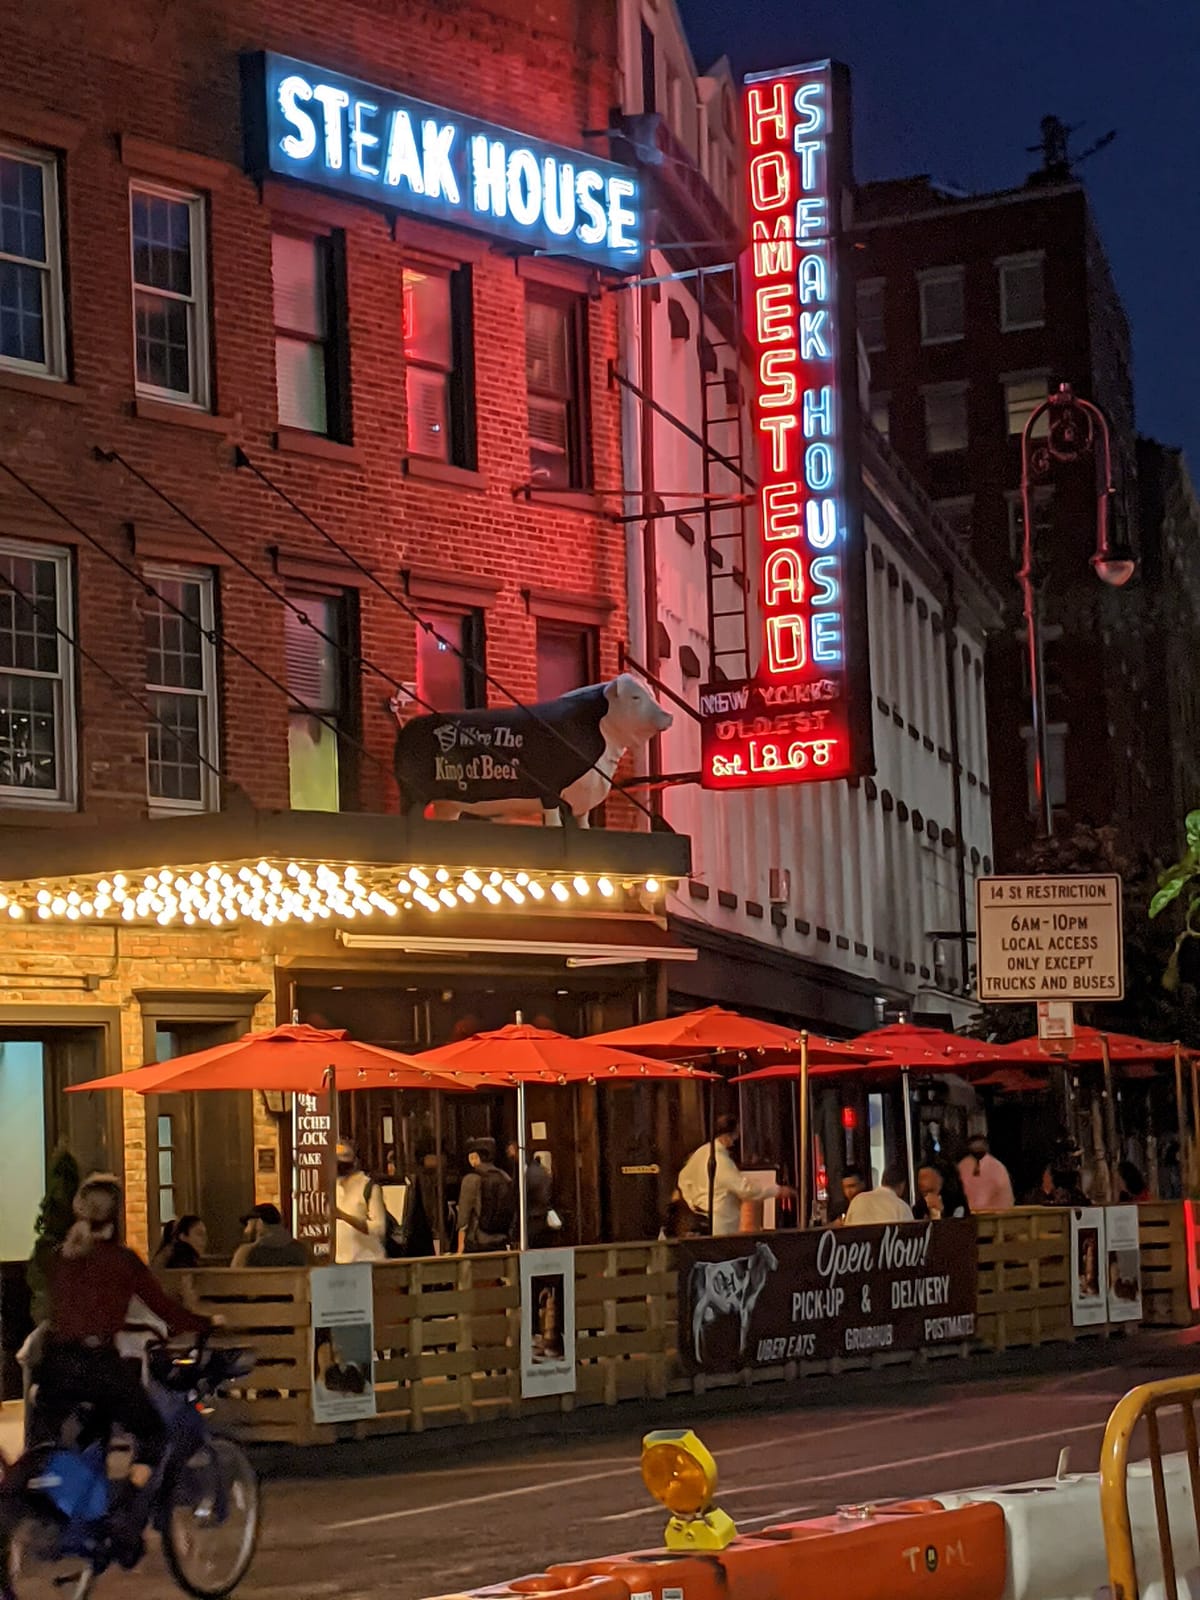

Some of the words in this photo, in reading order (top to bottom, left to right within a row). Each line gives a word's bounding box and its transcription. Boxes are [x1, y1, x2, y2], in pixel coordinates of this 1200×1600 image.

[278, 75, 460, 204] STEAK
[471, 134, 639, 253] HOUSE
[795, 83, 828, 361] STEAK
[748, 83, 806, 676] HOMESTEAD
[803, 385, 841, 664] HOUSE
[494, 727, 523, 748] The
[716, 710, 830, 740] OLDEST
[750, 740, 837, 772] 1868
[435, 757, 467, 791] King
[466, 758, 480, 779] of
[481, 755, 519, 779] Beef
[990, 886, 1003, 899] 14
[1026, 884, 1106, 898] RESTRICTION
[1002, 937, 1043, 950] LOCAL
[1048, 936, 1098, 950] ACCESS
[1007, 957, 1040, 970] ONLY
[1045, 956, 1094, 970] EXCEPT
[986, 977, 1036, 990] TRUCKS
[1041, 976, 1067, 989] AND
[1073, 976, 1116, 989] BUSES
[816, 1229, 873, 1290] Open
[877, 1222, 934, 1270] Now!
[860, 1284, 871, 1313] &
[891, 1275, 950, 1310] DELIVERY
[786, 1334, 816, 1357] EATS
